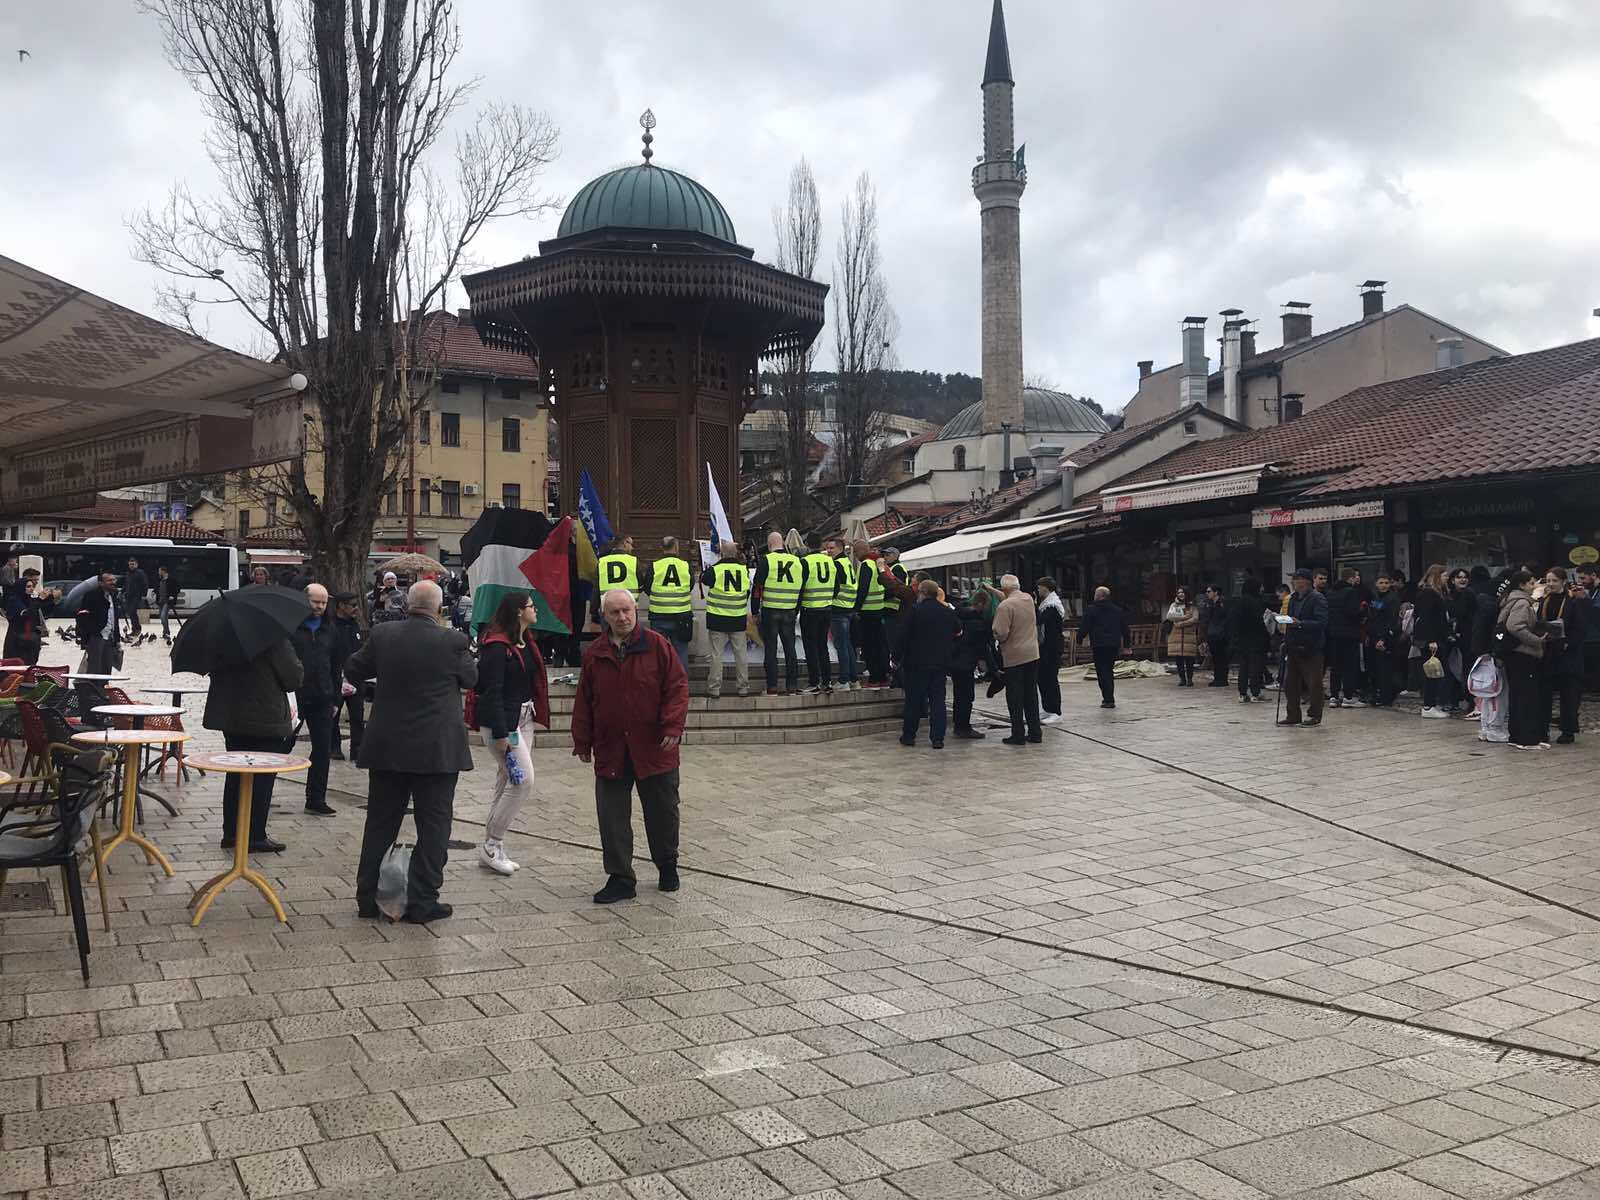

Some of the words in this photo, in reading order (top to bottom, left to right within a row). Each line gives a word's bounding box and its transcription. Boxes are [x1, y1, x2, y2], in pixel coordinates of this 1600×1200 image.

[607, 561, 628, 584] D
[661, 564, 682, 587] A
[723, 569, 742, 592] N
[777, 560, 794, 583] K
[816, 562, 830, 584] U
